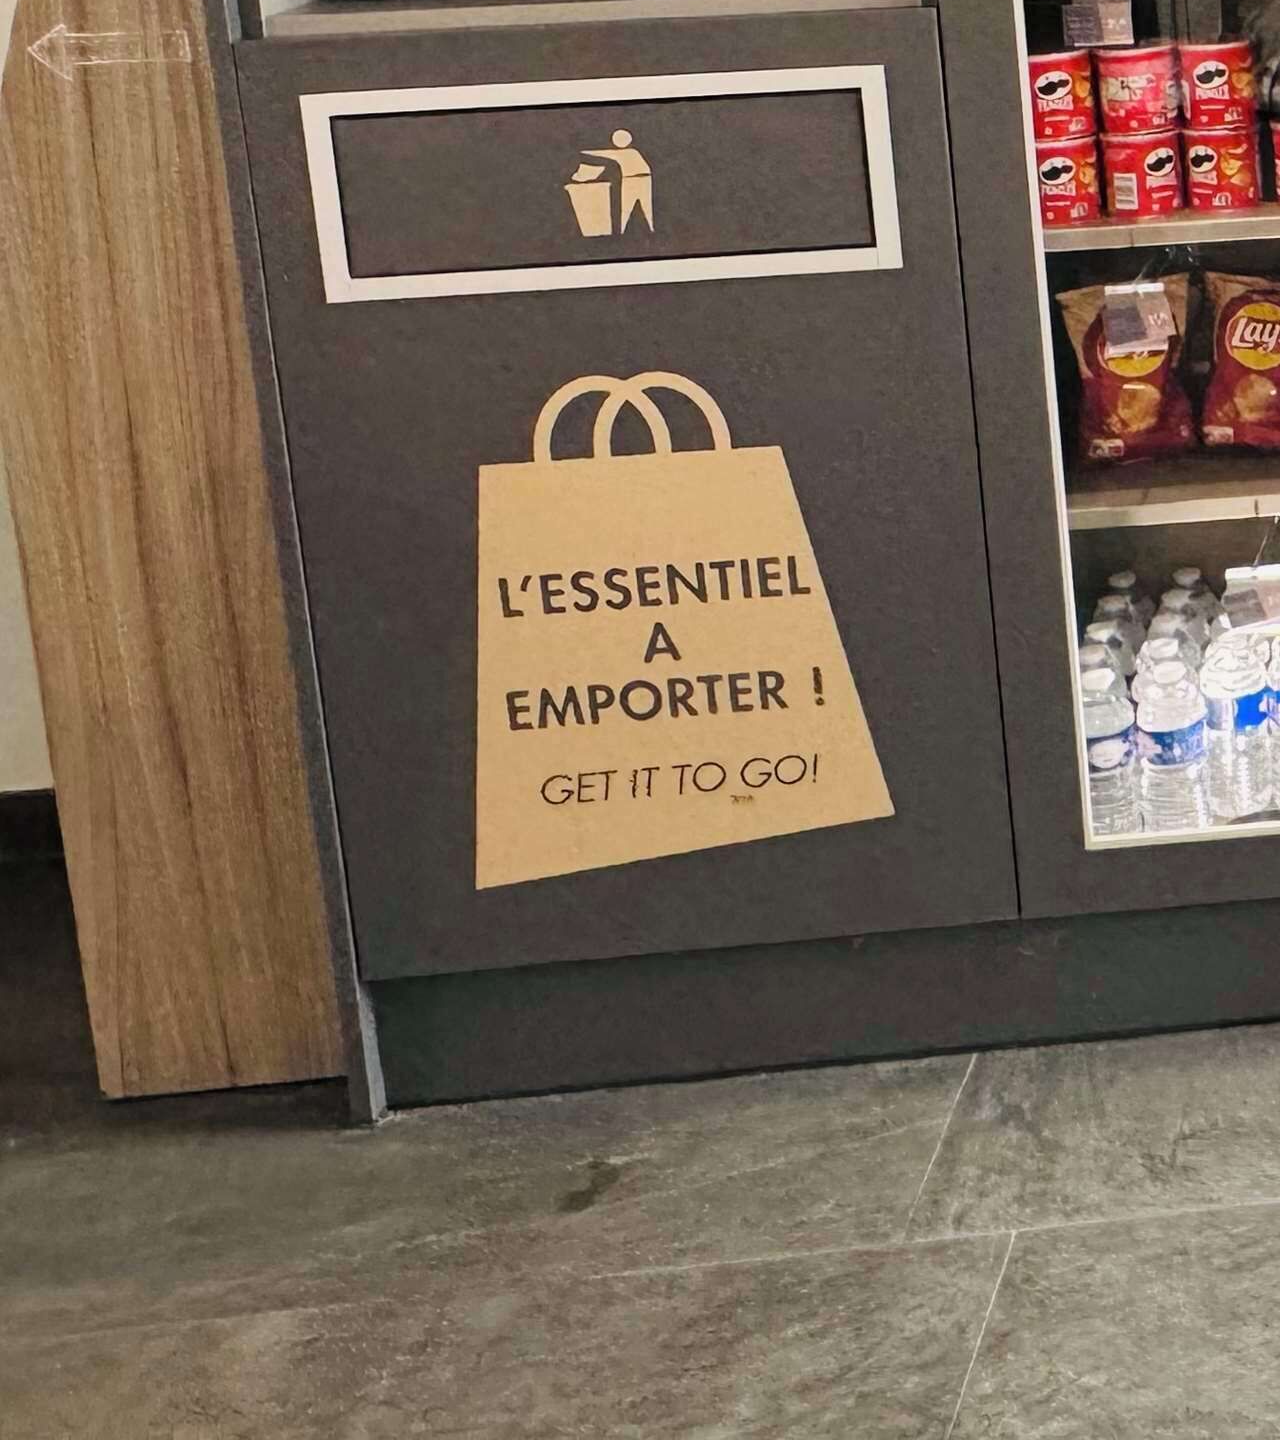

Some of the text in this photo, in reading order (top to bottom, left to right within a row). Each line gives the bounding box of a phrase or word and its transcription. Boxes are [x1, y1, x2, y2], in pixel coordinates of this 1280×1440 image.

[644, 622, 682, 663] A
[506, 665, 825, 731] EMPORTER !
[540, 753, 820, 806] GET IT TO GO!
